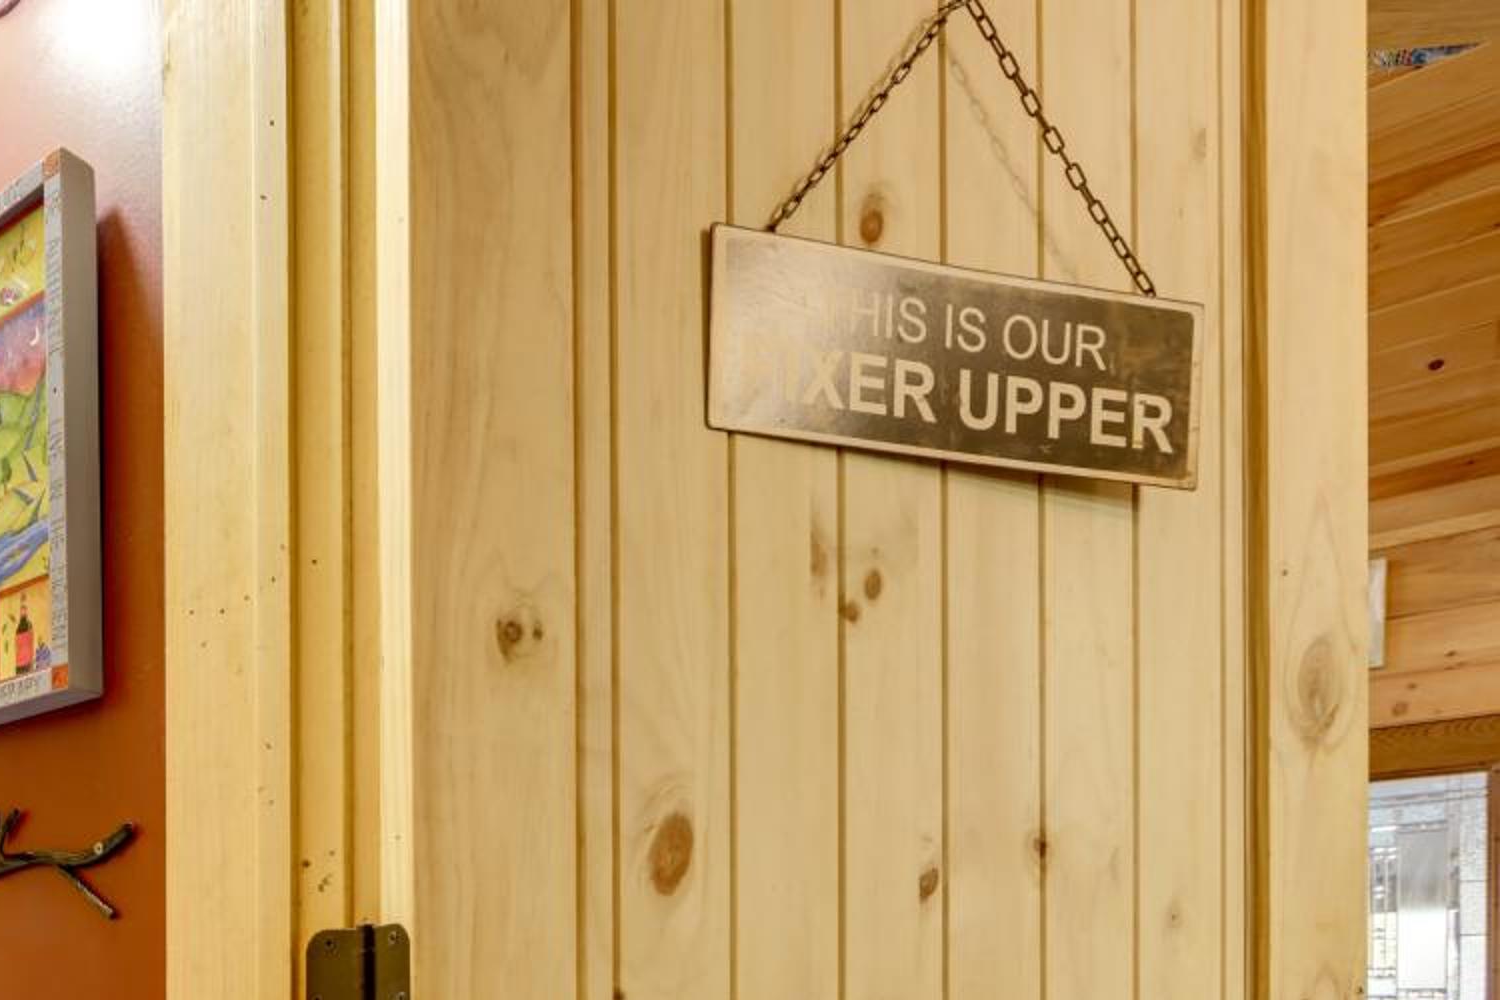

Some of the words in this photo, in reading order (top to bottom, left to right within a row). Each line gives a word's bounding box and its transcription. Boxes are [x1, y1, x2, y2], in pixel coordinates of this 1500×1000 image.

[944, 303, 987, 353] IS
[1003, 313, 1107, 373] OUR
[957, 366, 1175, 456] UPPER
